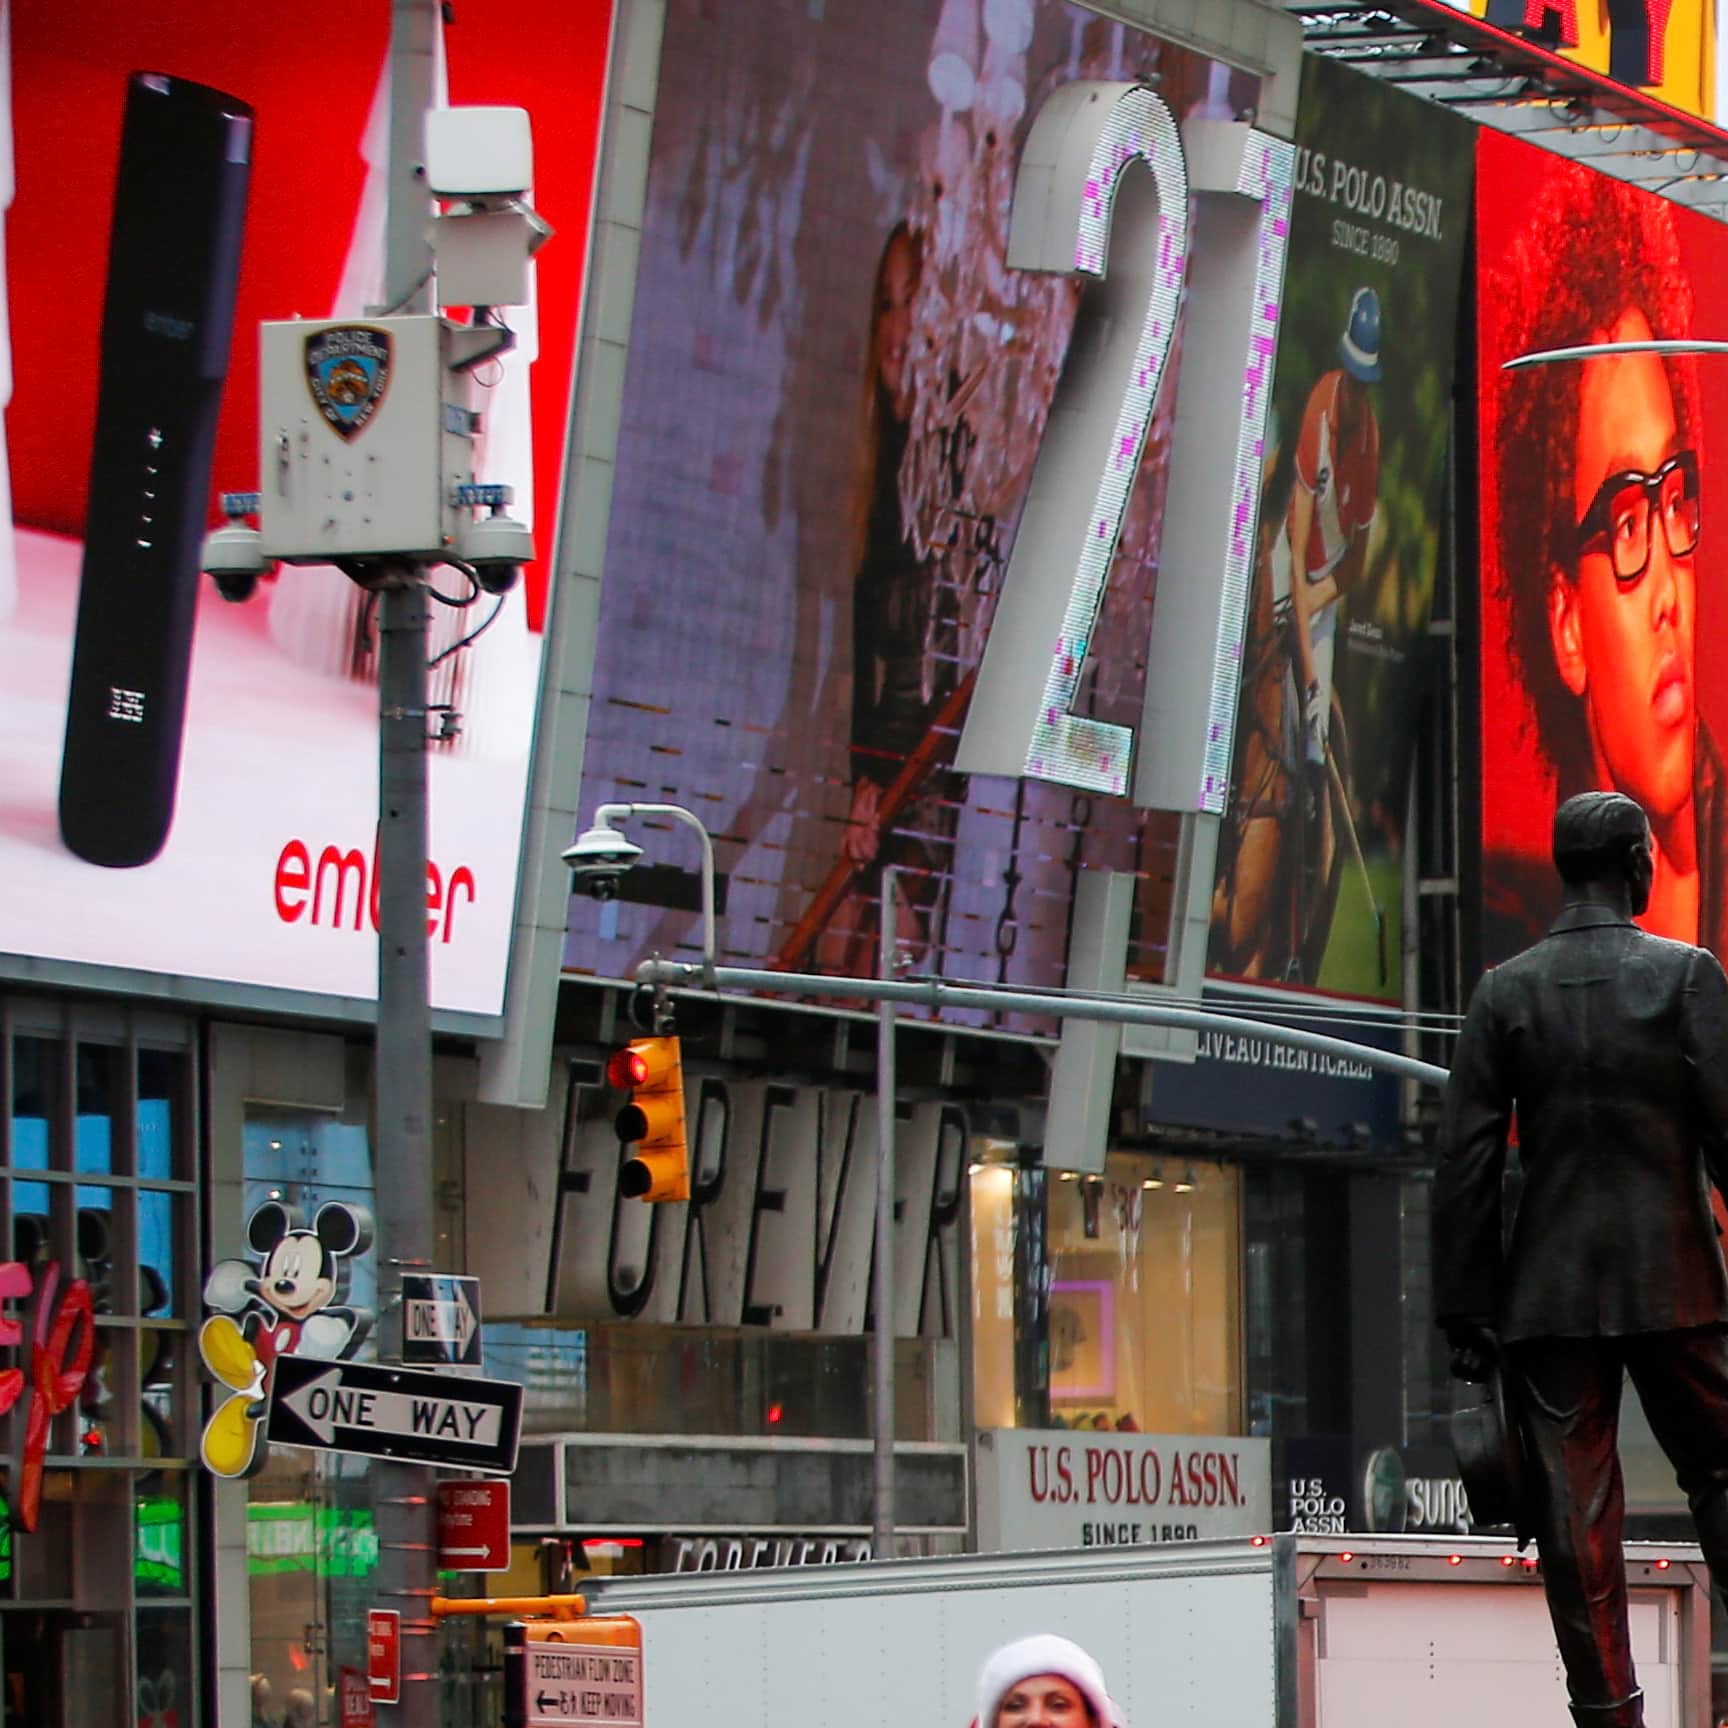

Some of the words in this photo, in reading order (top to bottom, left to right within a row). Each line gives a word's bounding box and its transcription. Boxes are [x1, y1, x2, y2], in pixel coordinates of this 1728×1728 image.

[1295, 146, 1327, 198] U.S.
[1330, 160, 1386, 218] POLO
[1386, 182, 1443, 241] ASSN.
[1332, 219, 1370, 255] SINCE
[274, 820, 475, 944] emr
[414, 1304, 436, 1337] ONE
[309, 1389, 376, 1427] ONE
[411, 1399, 487, 1440] WAY
[1027, 1445, 1080, 1505] U.S.
[1086, 1447, 1162, 1505] POLO
[1168, 1450, 1247, 1507] ASSN.
[1291, 1478, 1328, 1498] U.S.
[1291, 1498, 1346, 1516] POLO
[1082, 1523, 1142, 1547] SINCE
[1292, 1517, 1350, 1534] ASSN.
[535, 1654, 587, 1681] PEDESTRIAN
[588, 1657, 612, 1682] FLOW
[613, 1659, 635, 1683] ZONE
[581, 1691, 601, 1716] KEEP
[604, 1693, 636, 1717] MOVING
